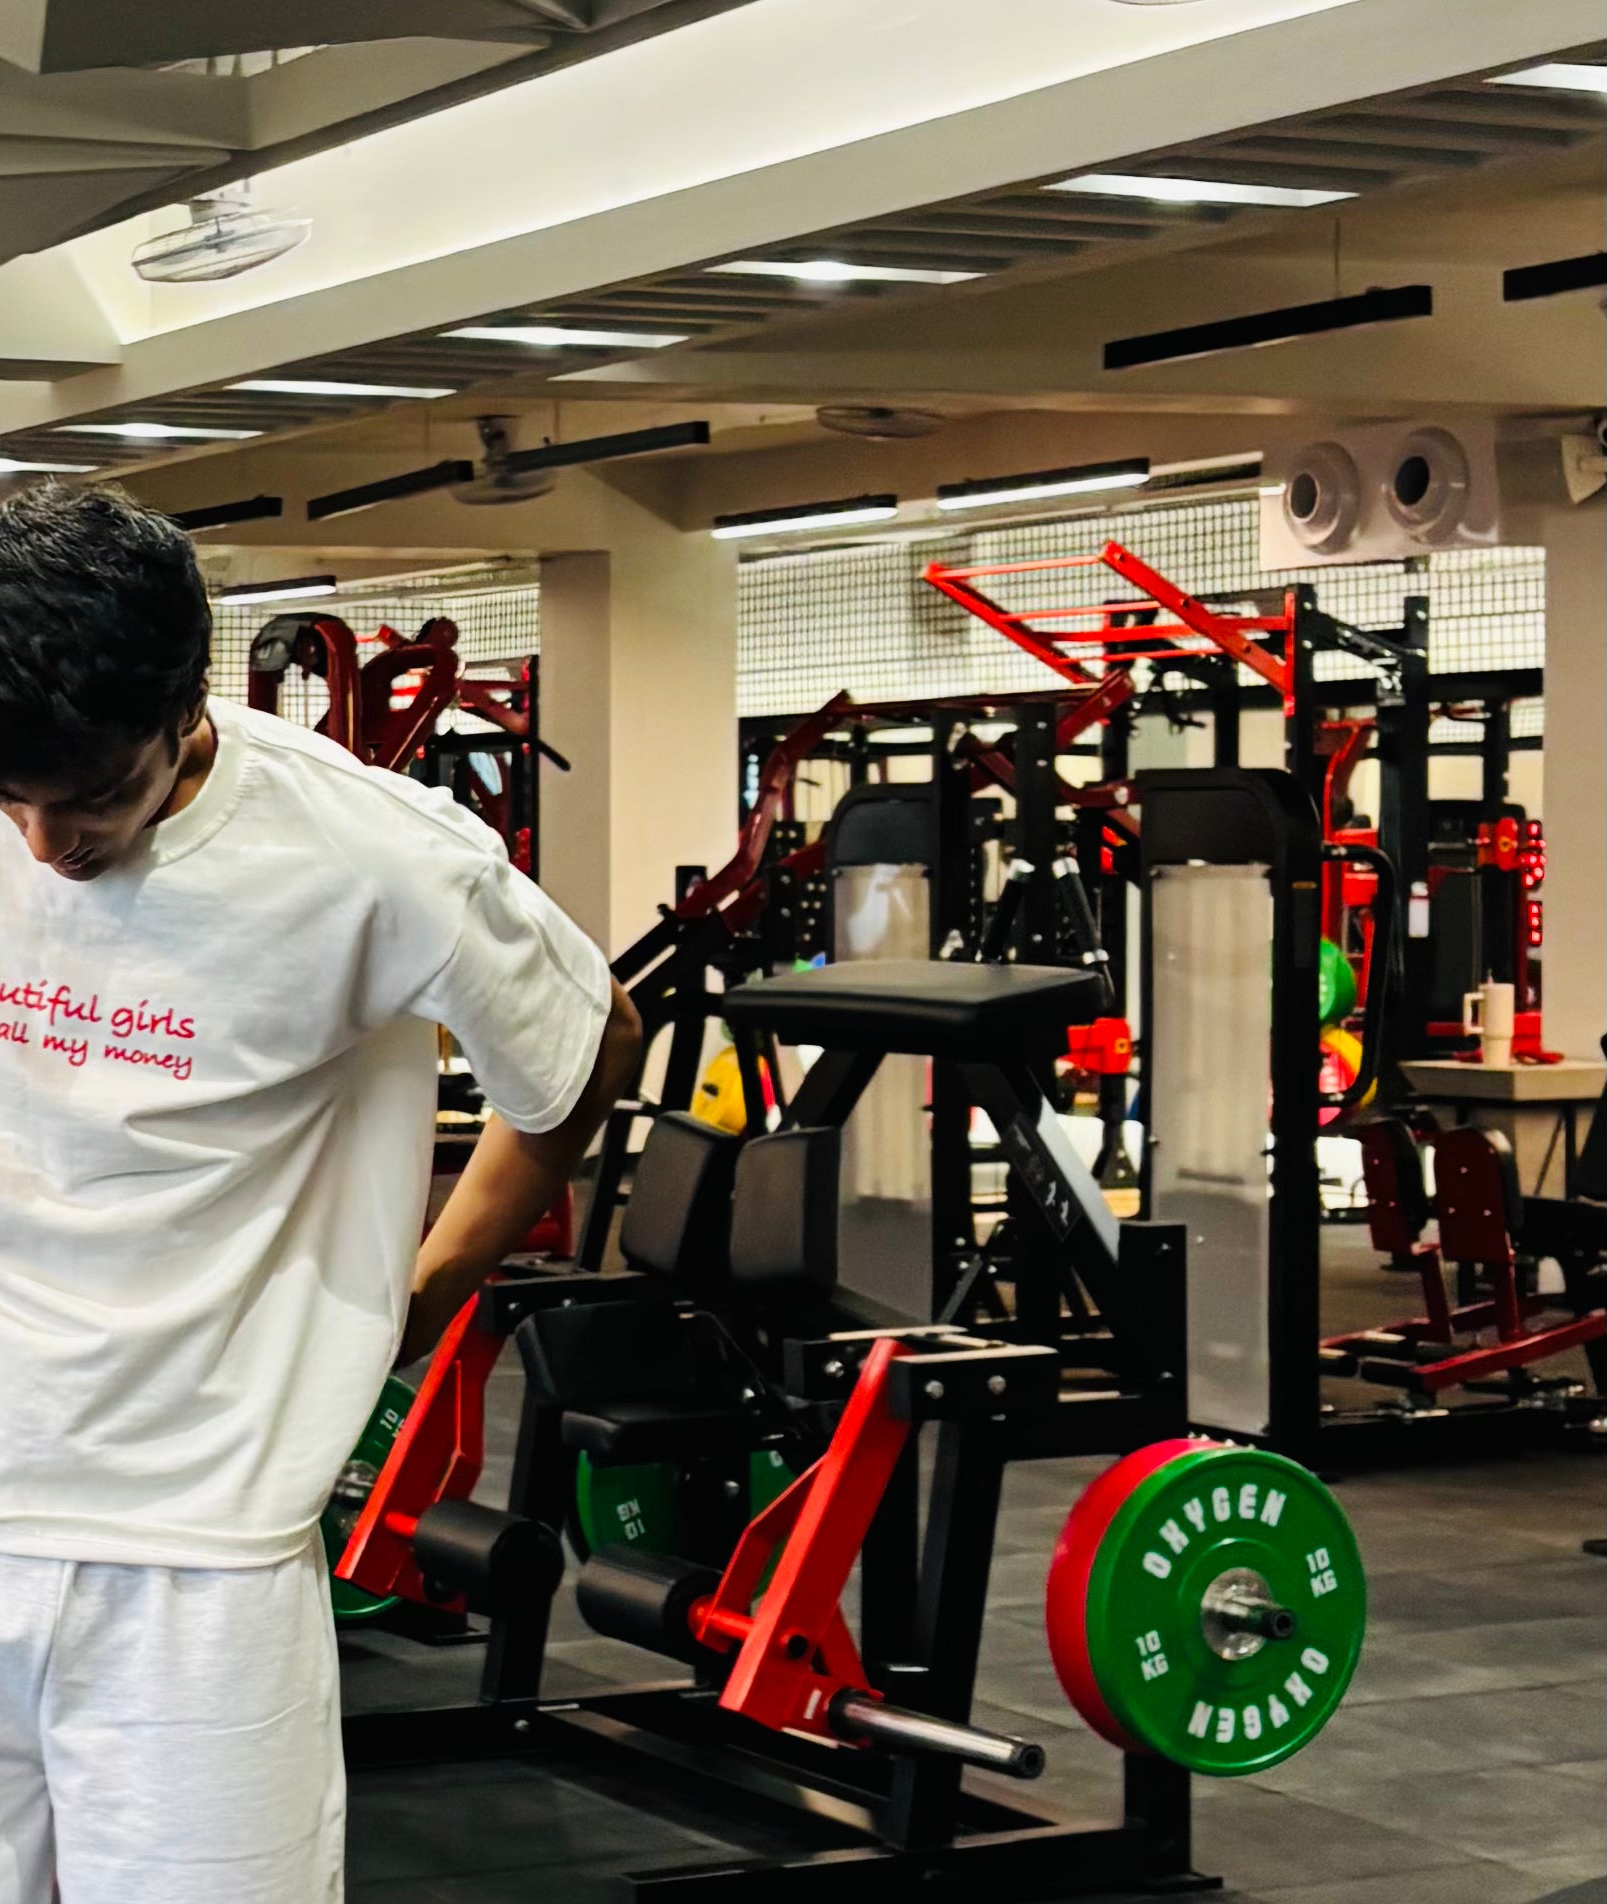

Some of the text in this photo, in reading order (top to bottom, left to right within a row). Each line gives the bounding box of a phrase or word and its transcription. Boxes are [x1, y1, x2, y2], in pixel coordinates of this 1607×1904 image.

[110, 999, 196, 1039] girls
[43, 1034, 89, 1066] my
[104, 1044, 192, 1080] money
[380, 1408, 399, 1430] 10
[1143, 1483, 1287, 1580] OXYGEN
[1306, 1547, 1331, 1574] 10
[1310, 1570, 1337, 1598] KG
[1135, 1629, 1162, 1657] 10
[1140, 1653, 1169, 1681] KG
[1187, 1647, 1331, 1744] OXYGEN
